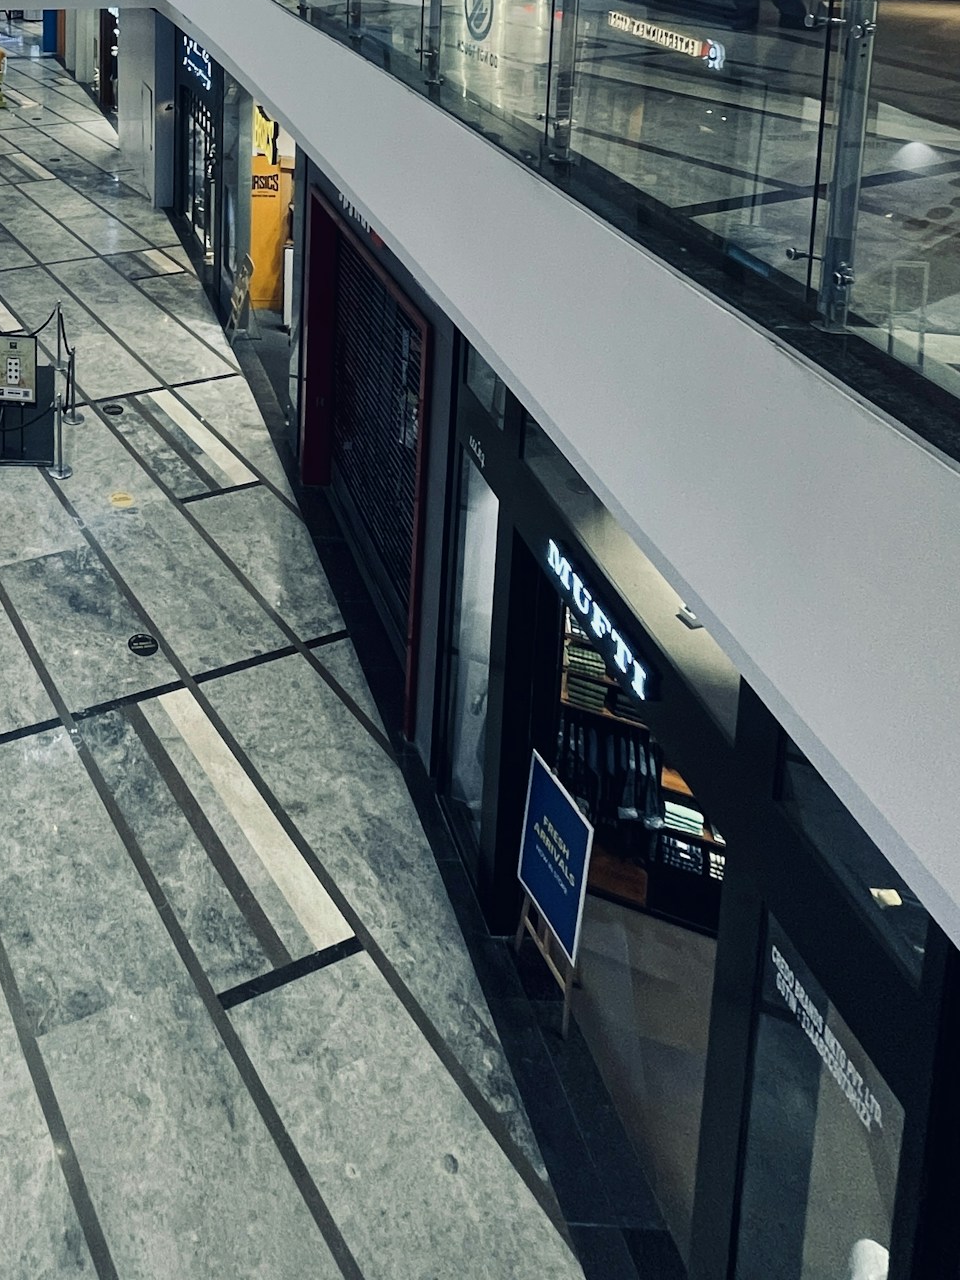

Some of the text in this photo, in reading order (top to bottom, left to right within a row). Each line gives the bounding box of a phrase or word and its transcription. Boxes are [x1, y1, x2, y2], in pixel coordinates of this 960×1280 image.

[547, 538, 647, 701] MUFTI
[533, 822, 575, 888] ARRIVALS
[543, 815, 570, 861] FRESH
